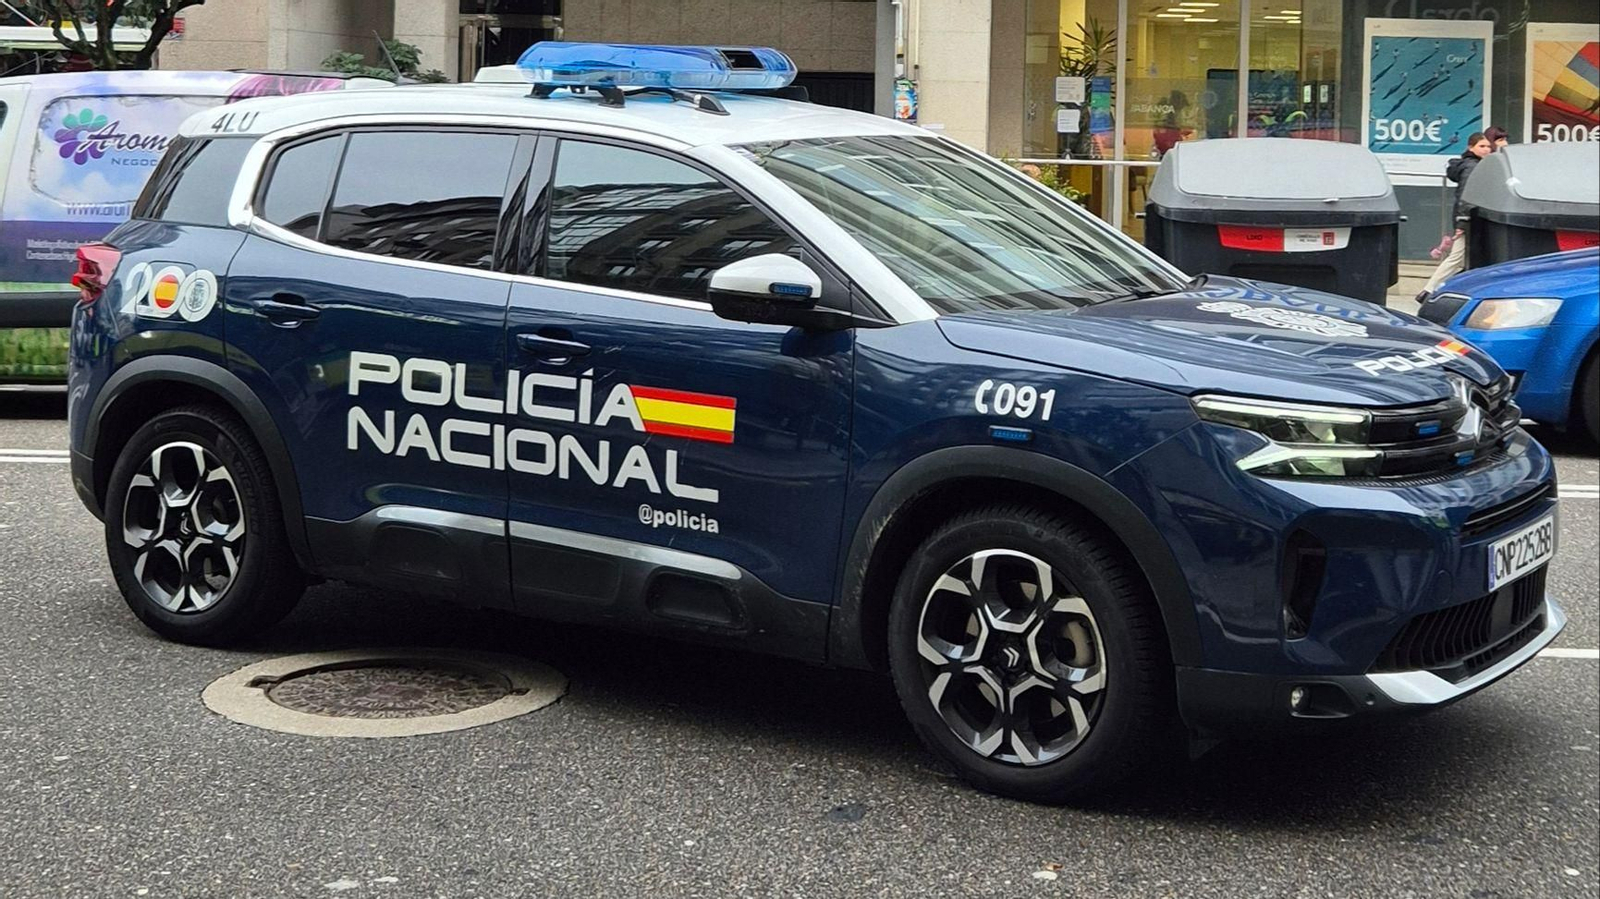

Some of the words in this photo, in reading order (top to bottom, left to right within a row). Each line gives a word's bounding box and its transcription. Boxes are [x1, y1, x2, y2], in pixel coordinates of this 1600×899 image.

[211, 111, 260, 132] 4LU
[347, 350, 647, 432] POLICÍA
[993, 382, 1056, 421] 091
[347, 405, 719, 503] NACIONAL
[638, 504, 719, 533] @policia
